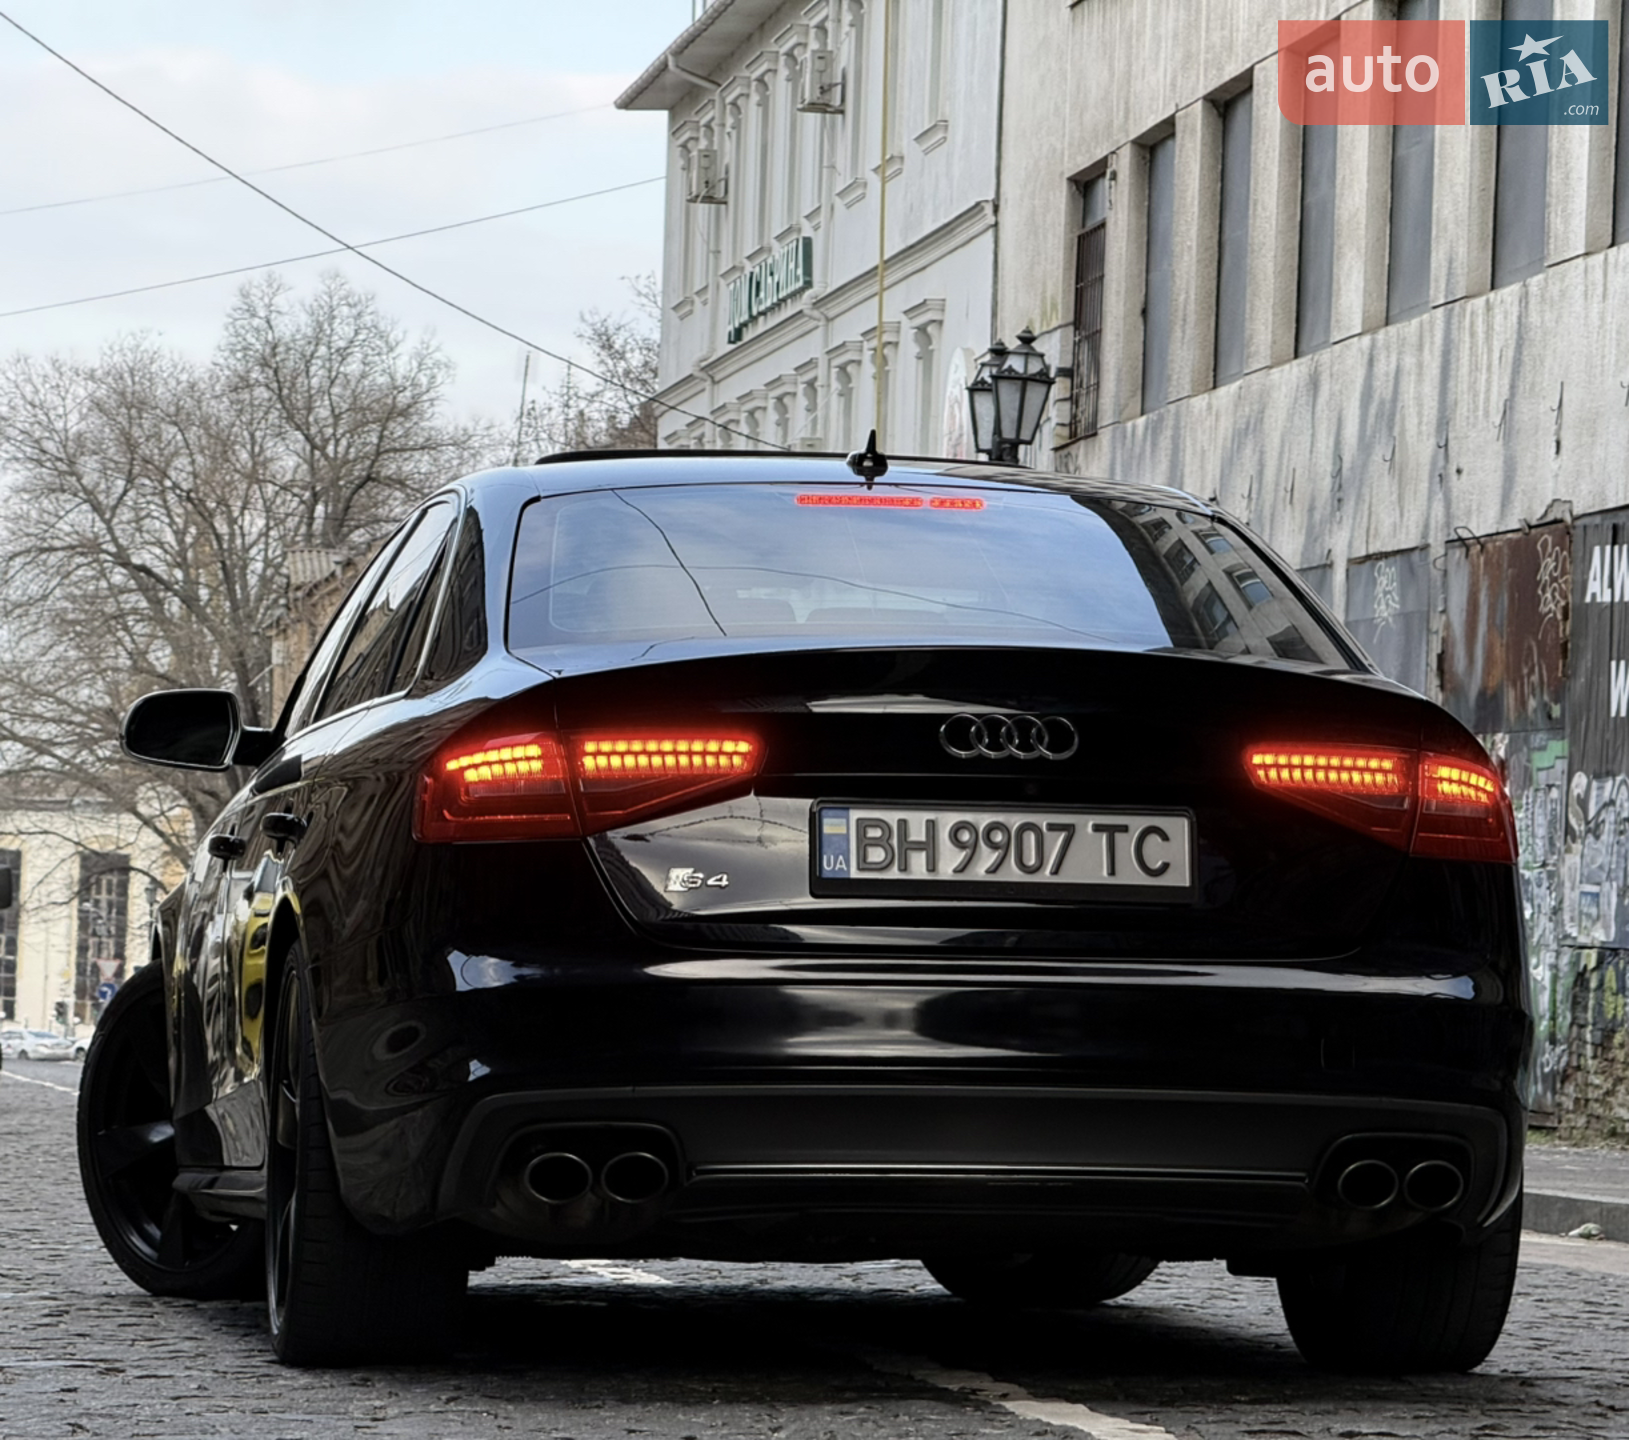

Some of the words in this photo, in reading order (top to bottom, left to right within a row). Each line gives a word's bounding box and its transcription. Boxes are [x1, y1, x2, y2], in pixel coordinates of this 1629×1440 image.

[855, 817, 936, 873] BH
[948, 820, 1076, 876] 9907
[1090, 822, 1171, 878] TC
[823, 854, 847, 871] UA
[673, 869, 729, 890] S4
